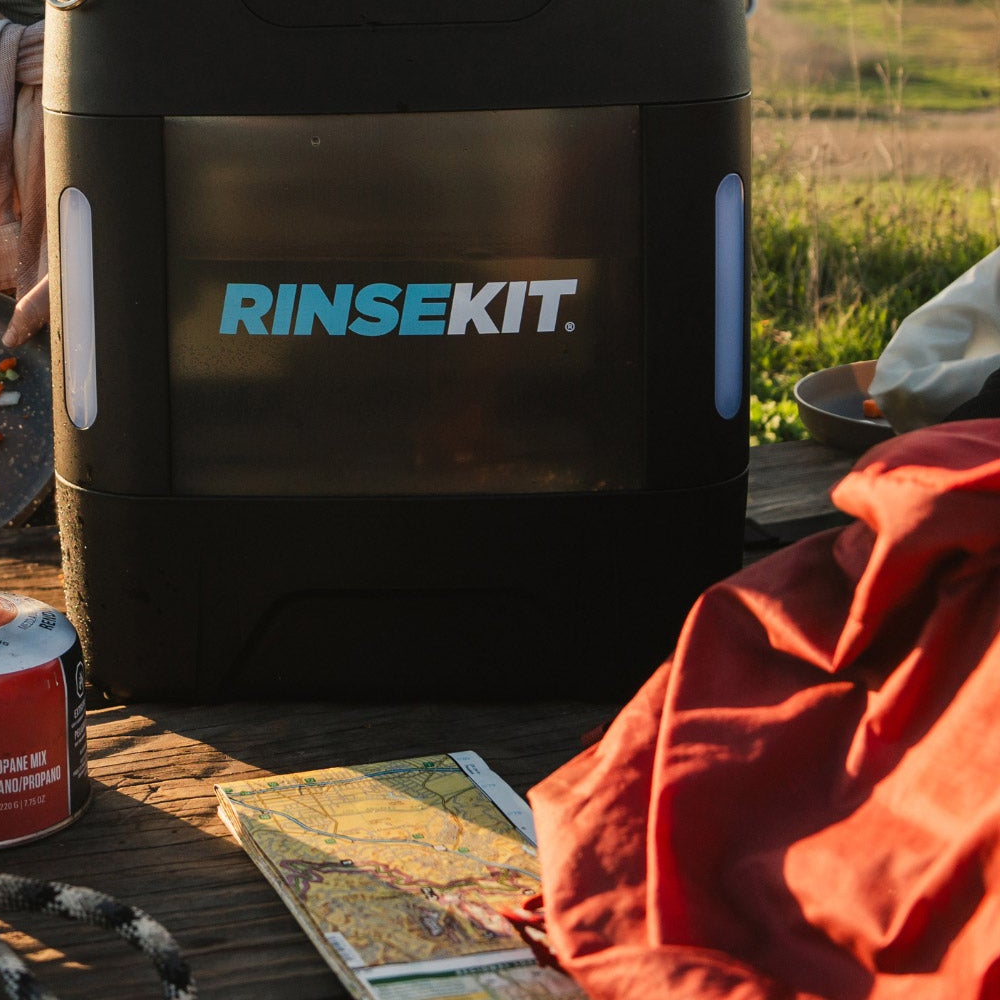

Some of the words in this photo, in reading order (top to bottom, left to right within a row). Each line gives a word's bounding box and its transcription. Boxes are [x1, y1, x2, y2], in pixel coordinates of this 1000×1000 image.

[219, 279, 578, 336] RINSEKIT
[30, 750, 47, 769] MIX
[0, 802, 12, 811] 220
